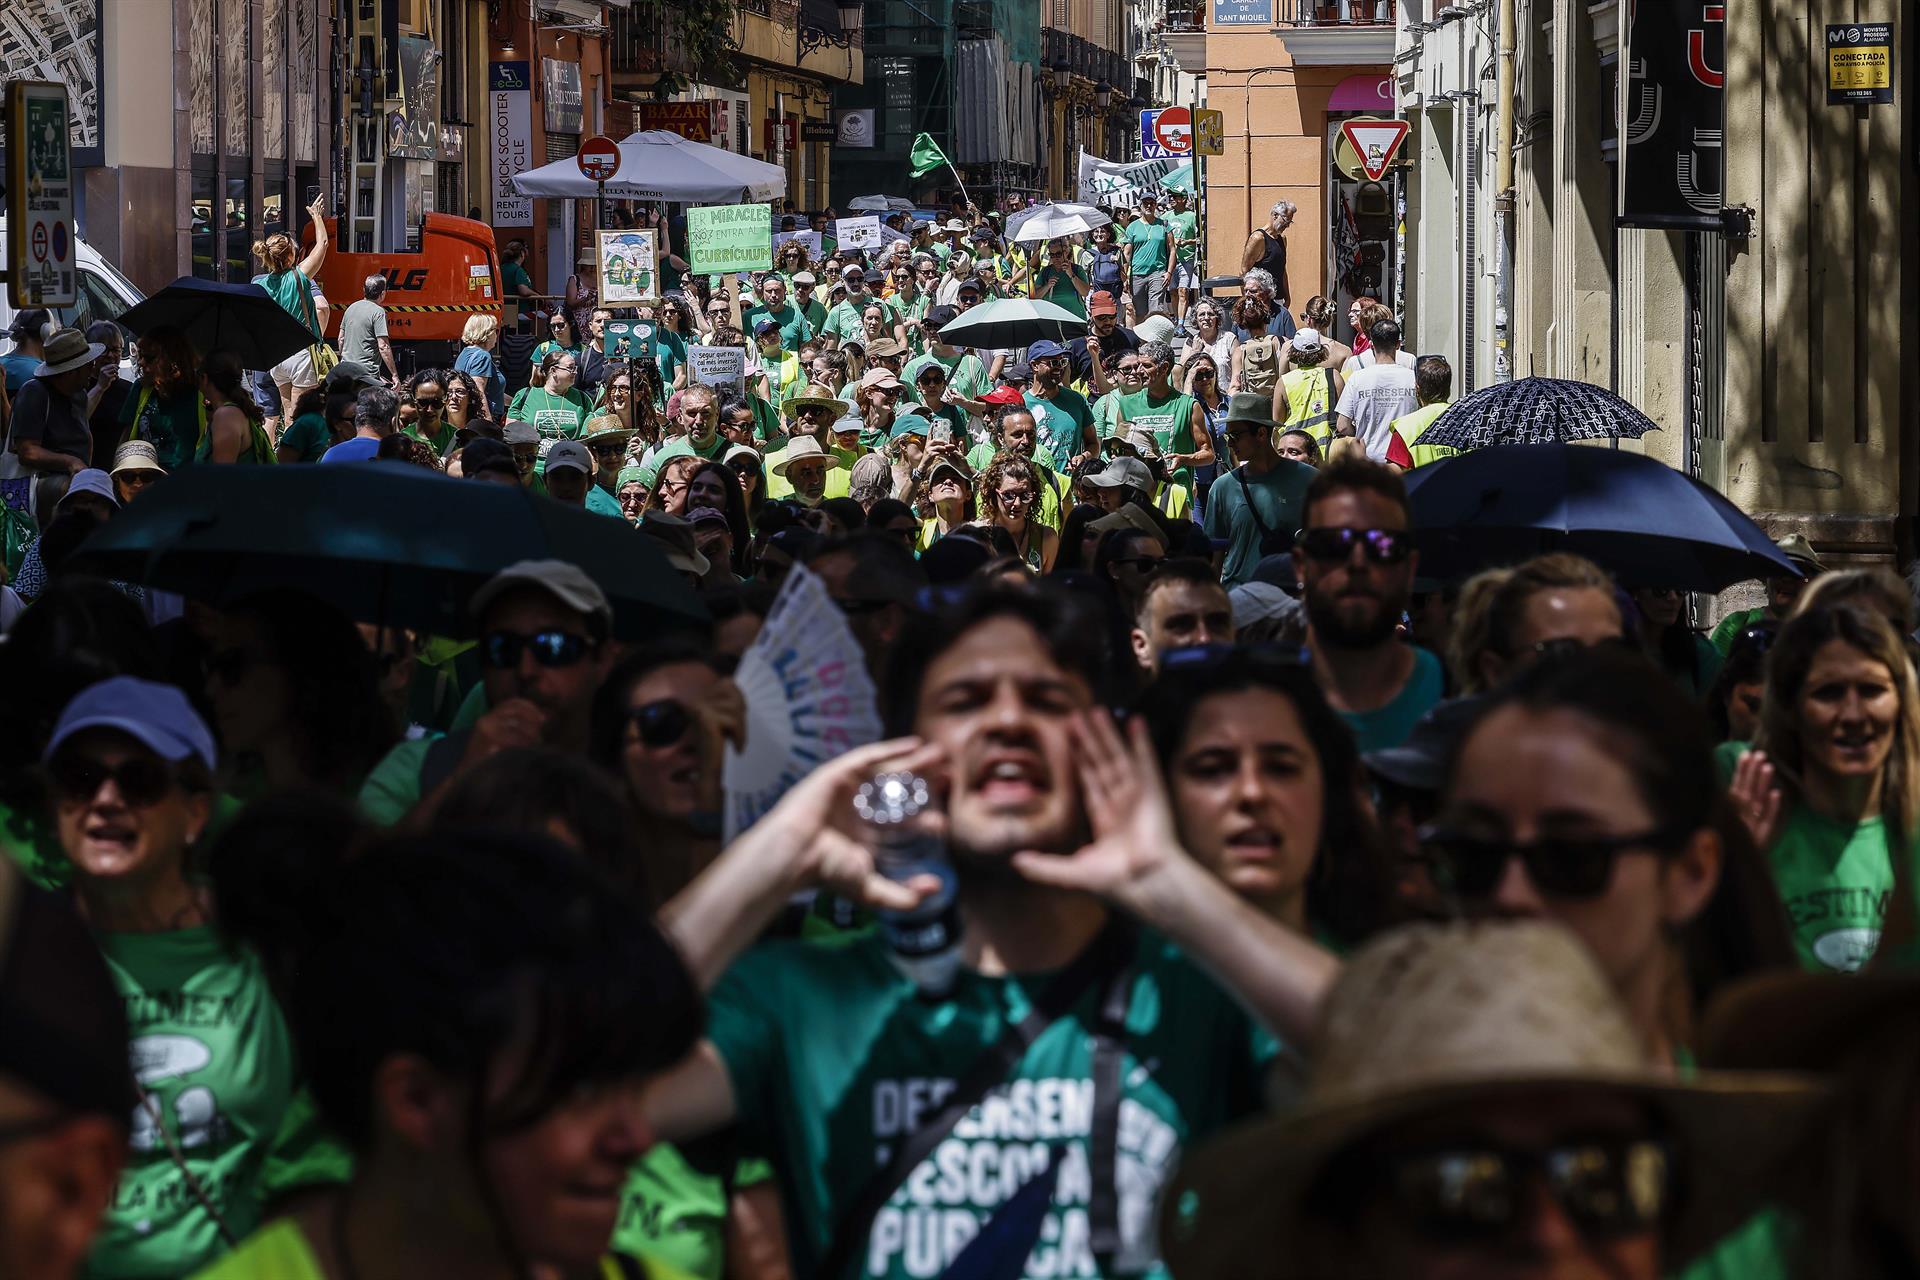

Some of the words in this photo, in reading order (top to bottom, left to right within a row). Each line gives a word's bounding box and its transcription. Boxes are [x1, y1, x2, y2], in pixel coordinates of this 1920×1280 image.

[1218, 14, 1238, 22] SANT
[1833, 53, 1886, 61] CONECTADA
[647, 104, 708, 119] BAZAR
[497, 92, 509, 154] SCOOTER
[806, 126, 834, 135] Mahou
[1088, 176, 1116, 194] SIX
[1124, 159, 1169, 189] SEVEN
[496, 201, 520, 209] RENT
[497, 210, 530, 219] TOURS
[716, 227, 744, 240] ENTRA
[748, 225, 758, 235] AL
[694, 244, 771, 263] CURRÍCULUM
[1358, 388, 1416, 399] REPRESENT
